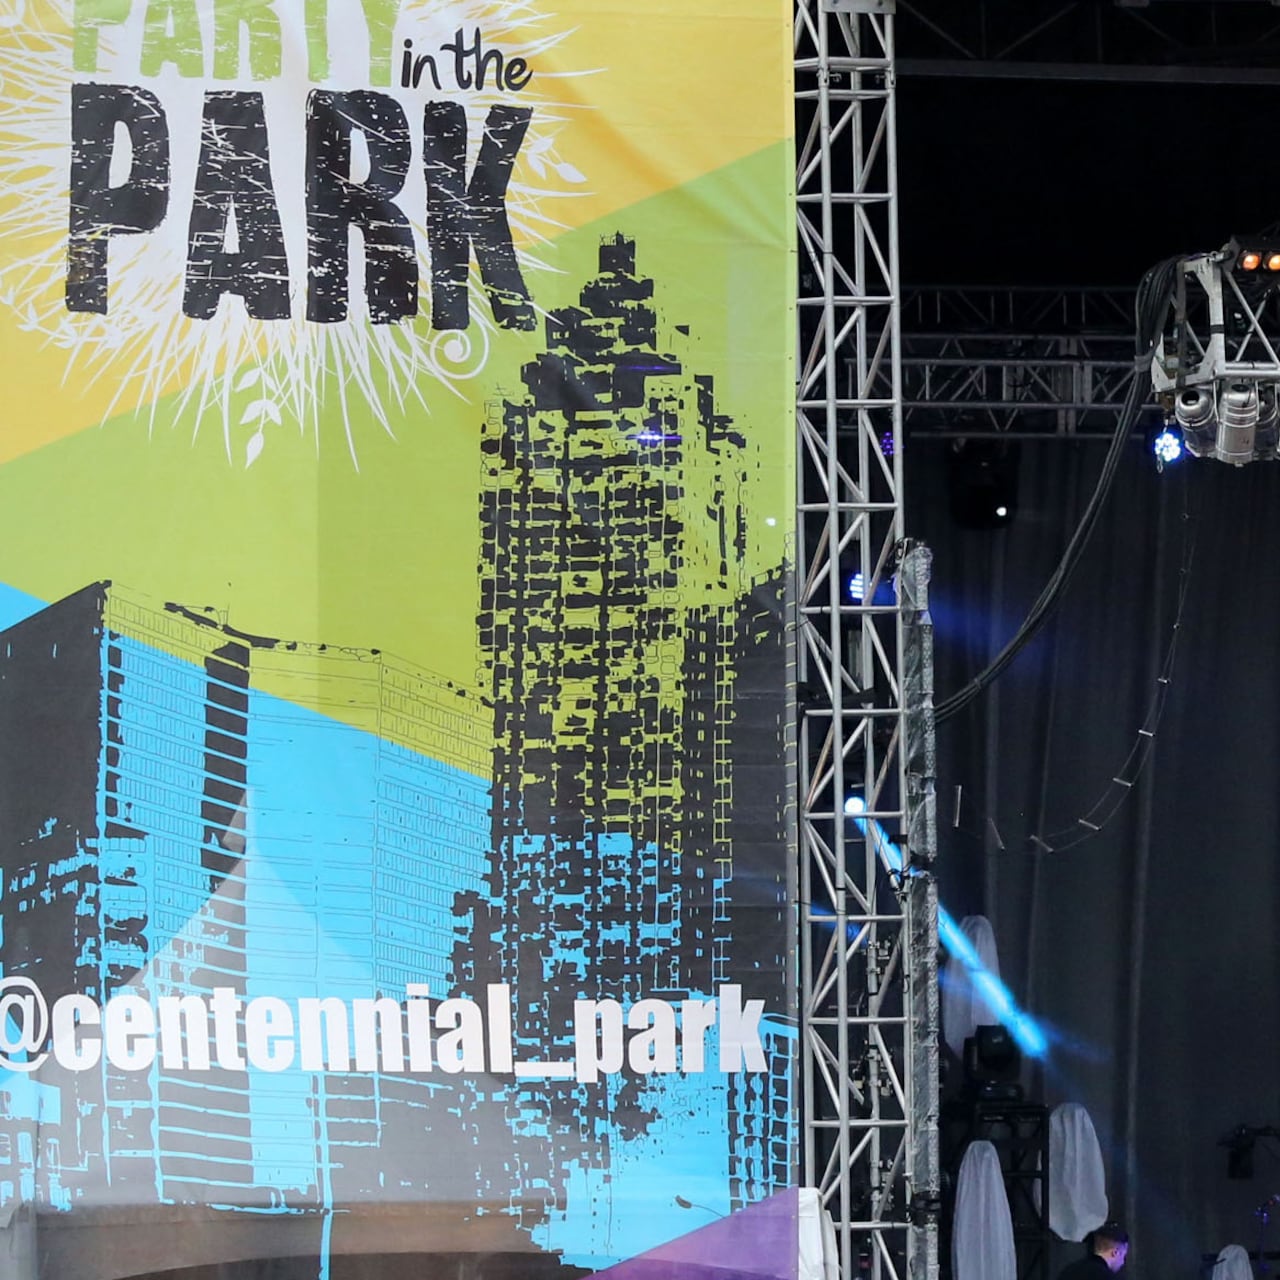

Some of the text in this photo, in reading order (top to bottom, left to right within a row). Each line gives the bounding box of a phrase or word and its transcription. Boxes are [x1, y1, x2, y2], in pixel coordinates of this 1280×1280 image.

[72, 0, 534, 92] PARTY in the
[64, 81, 537, 331] PARK
[0, 975, 769, 1084] @centennial_park
